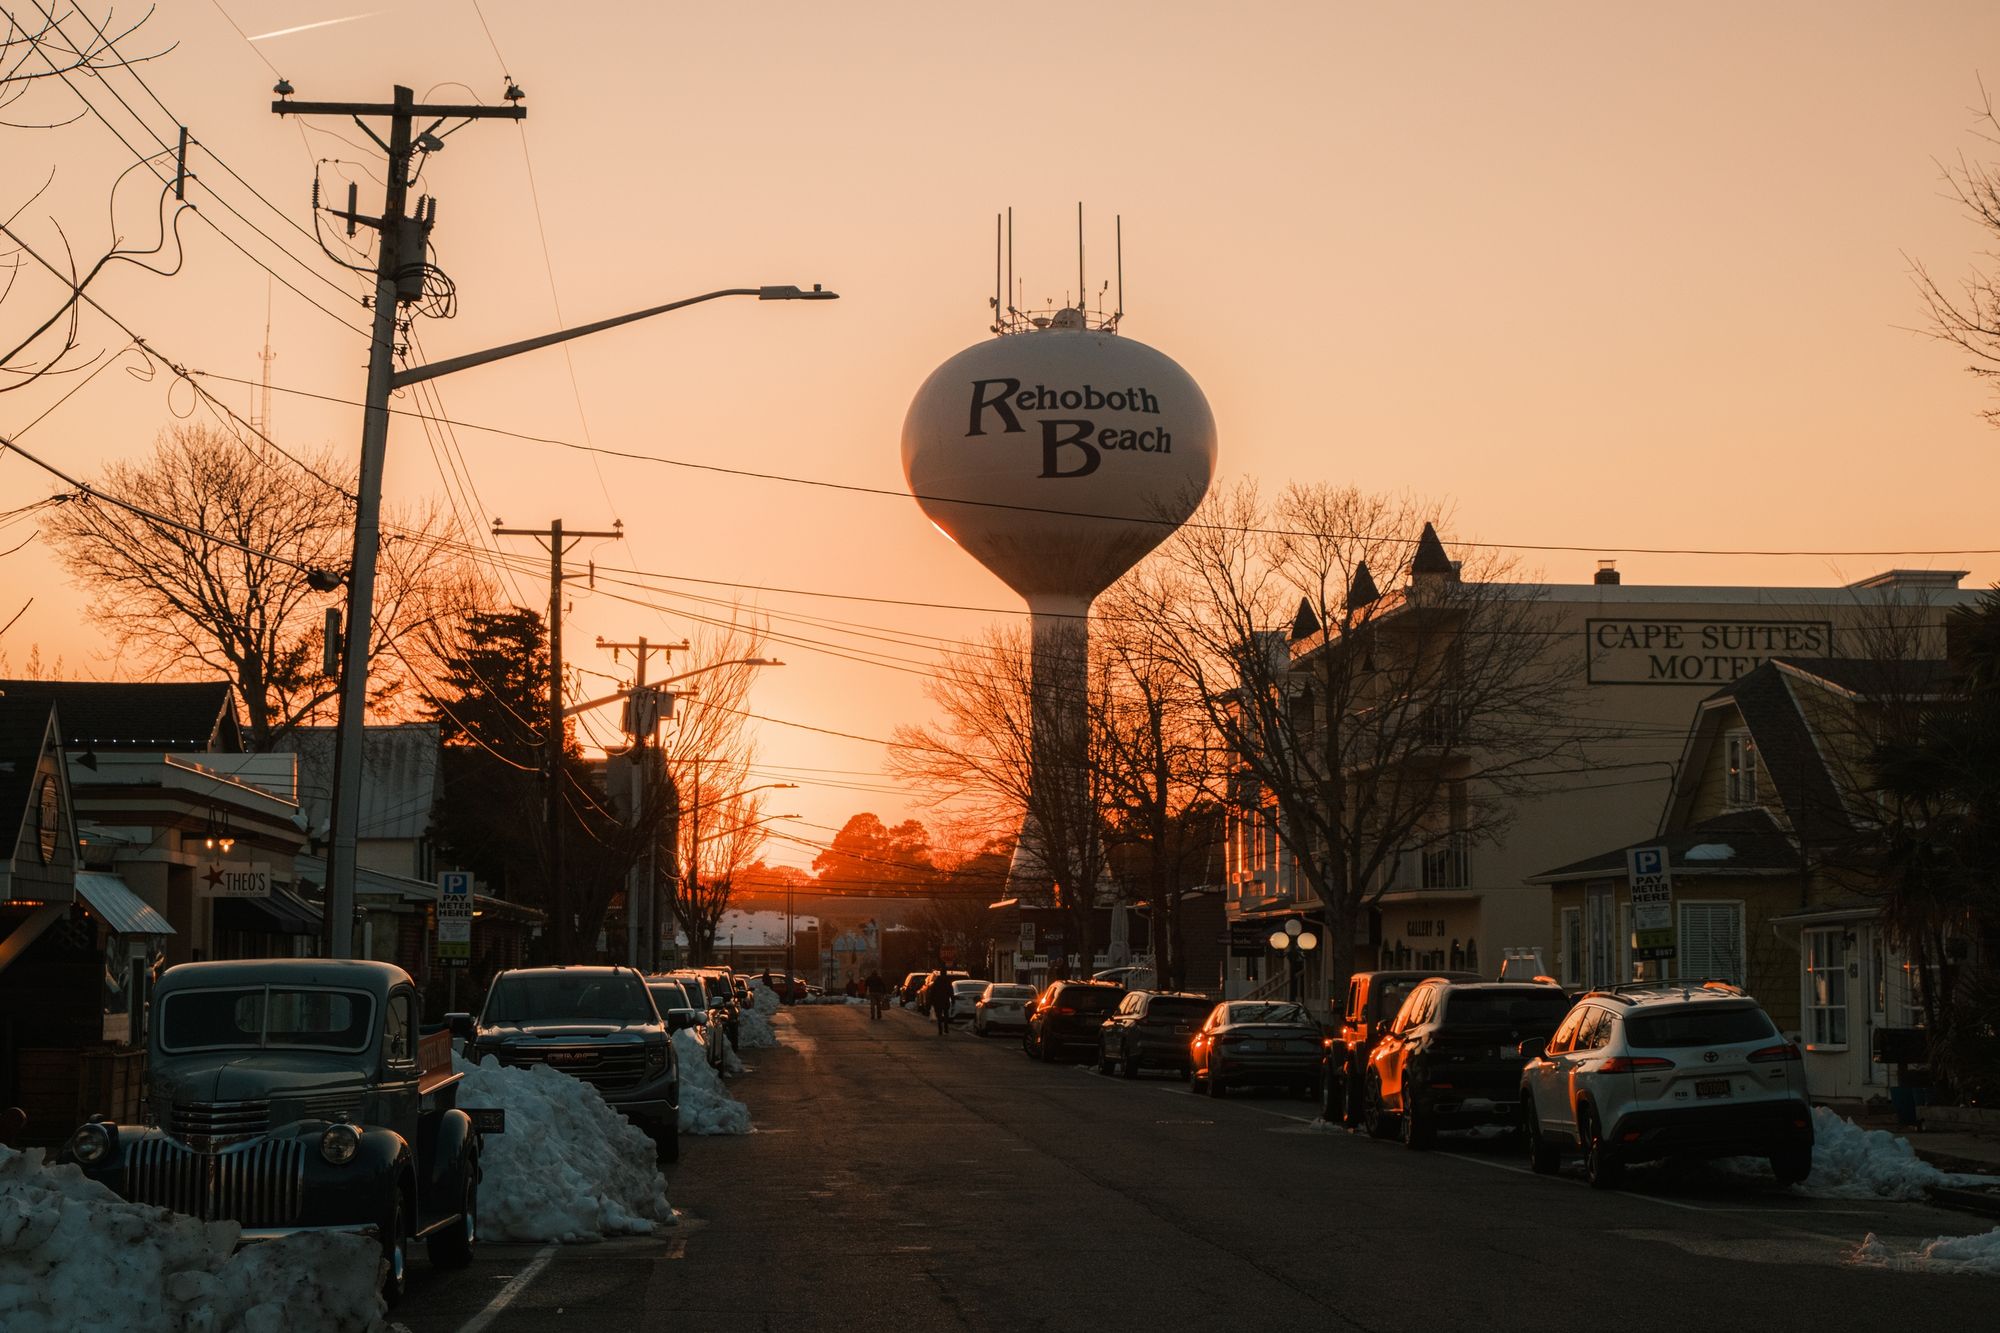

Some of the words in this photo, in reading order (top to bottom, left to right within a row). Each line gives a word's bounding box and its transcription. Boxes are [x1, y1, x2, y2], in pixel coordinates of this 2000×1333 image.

[965, 378, 1160, 437] Rehoboth
[1037, 420, 1171, 479] Beach
[1597, 624, 1684, 649] CAPE
[1702, 624, 1822, 650] SUITES
[225, 872, 265, 891] THEO'S
[1636, 875, 1663, 885] PAY
[1632, 884, 1669, 894] METER
[1633, 892, 1670, 903] HERE
[439, 909, 471, 917] HERE
